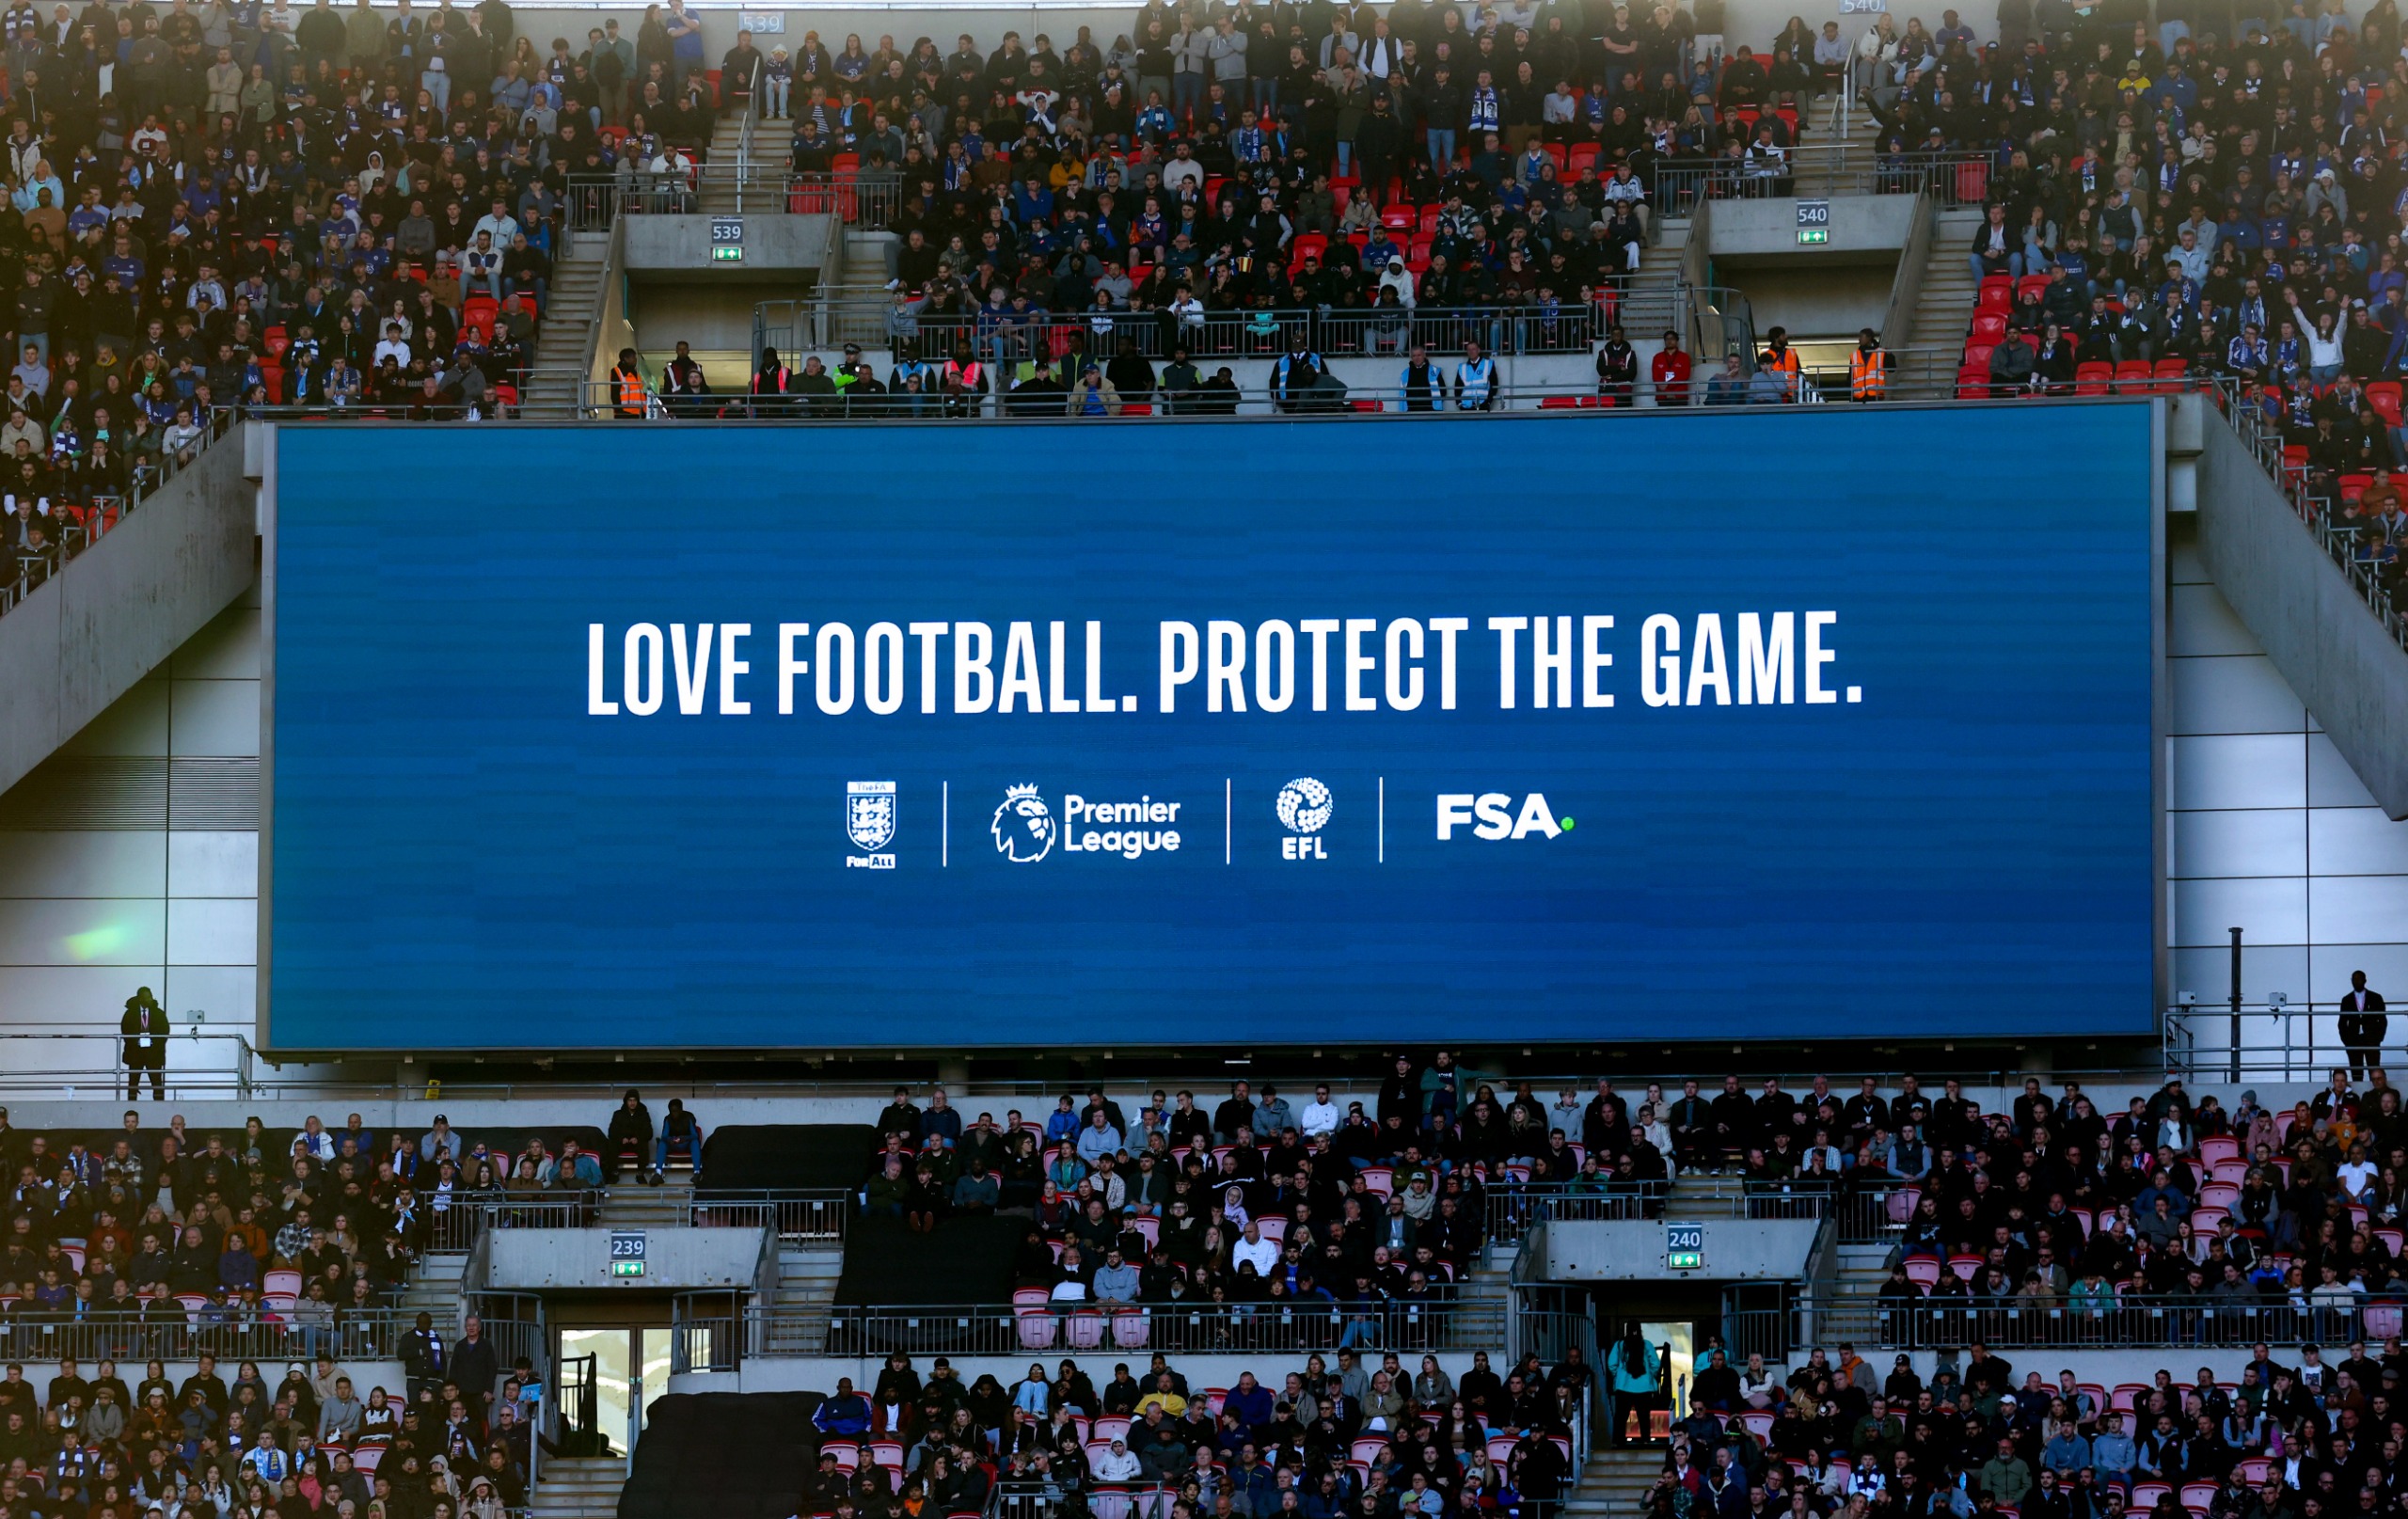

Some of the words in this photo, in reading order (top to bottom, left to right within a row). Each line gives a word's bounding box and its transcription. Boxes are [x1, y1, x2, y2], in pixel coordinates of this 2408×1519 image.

[744, 15, 780, 32] 539
[1798, 208, 1827, 222] 540
[713, 226, 741, 240] 539
[589, 623, 751, 717] LOVE
[779, 621, 1136, 716] FOOTBALL.
[1161, 618, 1468, 714] PROTECT
[1488, 615, 1614, 709] THE
[1641, 611, 1861, 707] GAME.
[1064, 794, 1181, 824] Premier
[1064, 827, 1181, 860] League
[1282, 836, 1328, 861] EFL
[612, 1240, 644, 1255] 239
[1670, 1232, 1701, 1247] 240
